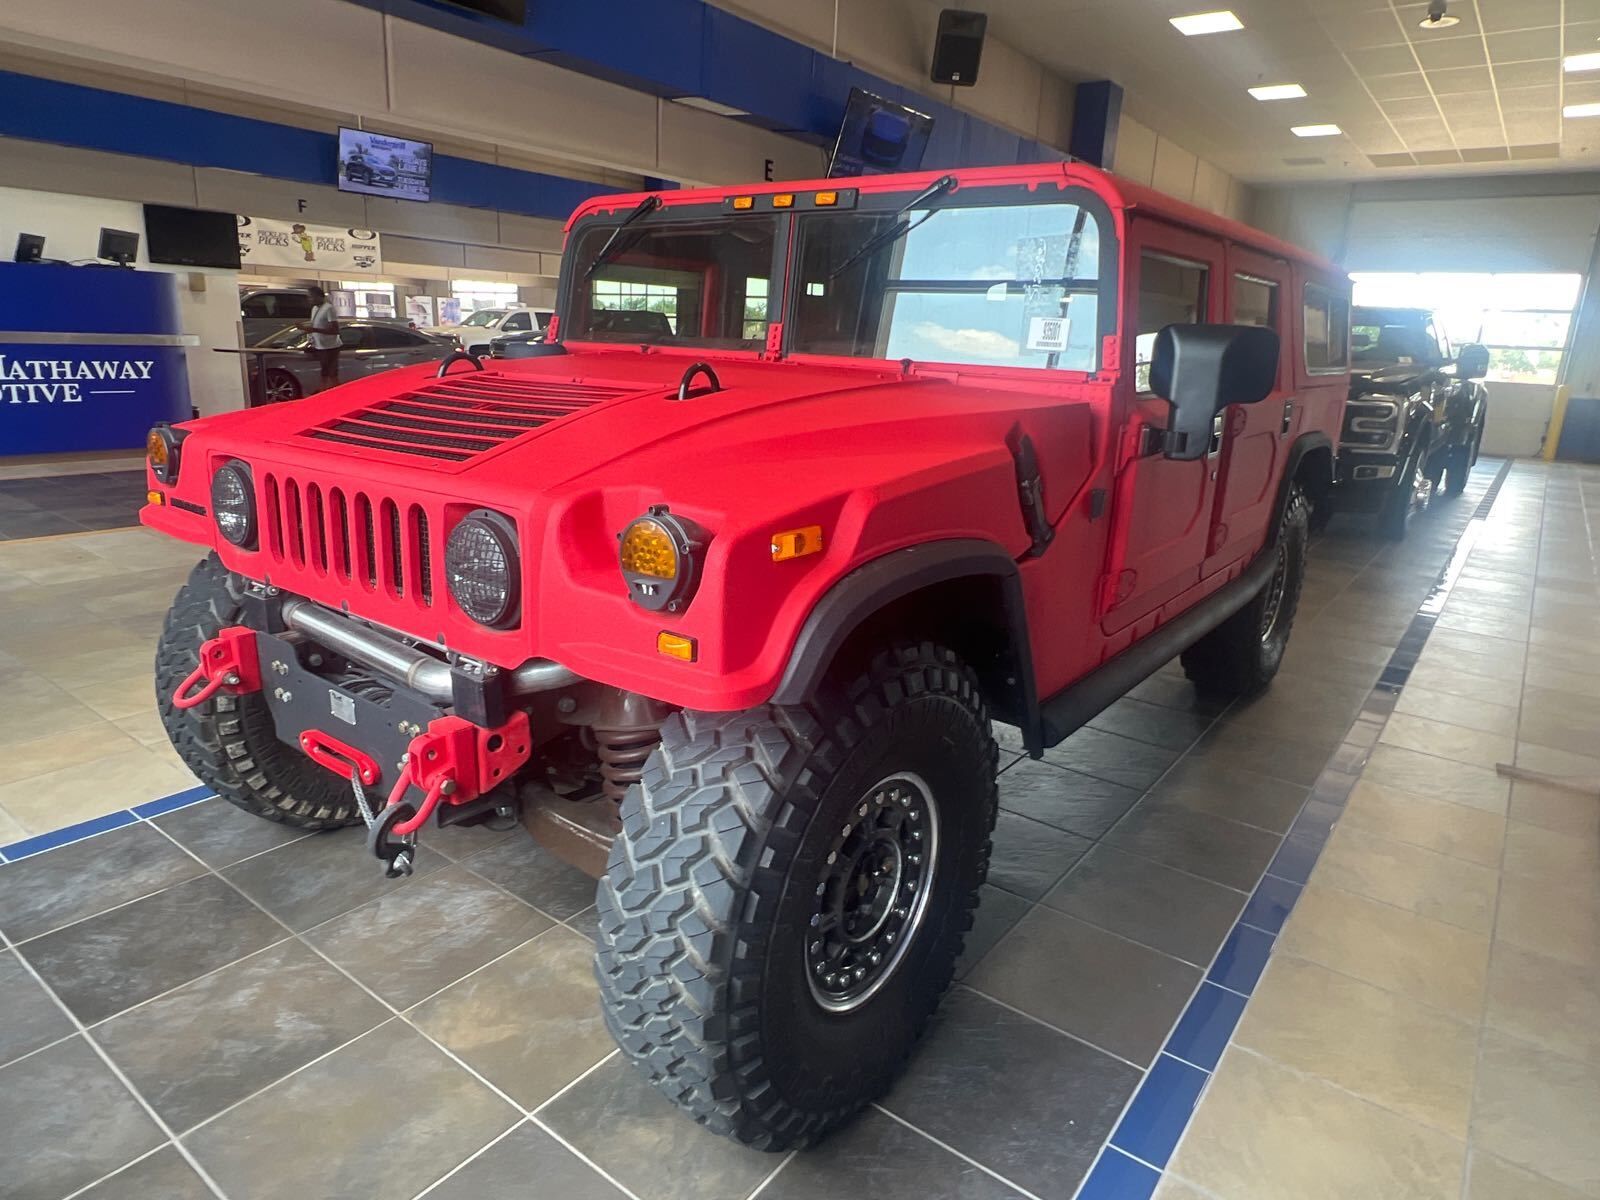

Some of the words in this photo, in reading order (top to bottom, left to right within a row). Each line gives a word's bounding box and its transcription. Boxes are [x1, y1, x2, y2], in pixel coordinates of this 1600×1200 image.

[764, 159, 774, 182] E
[297, 199, 307, 213] F
[258, 236, 289, 247] PICKS
[316, 241, 346, 252] PICKS
[0, 383, 82, 403] TIVE
